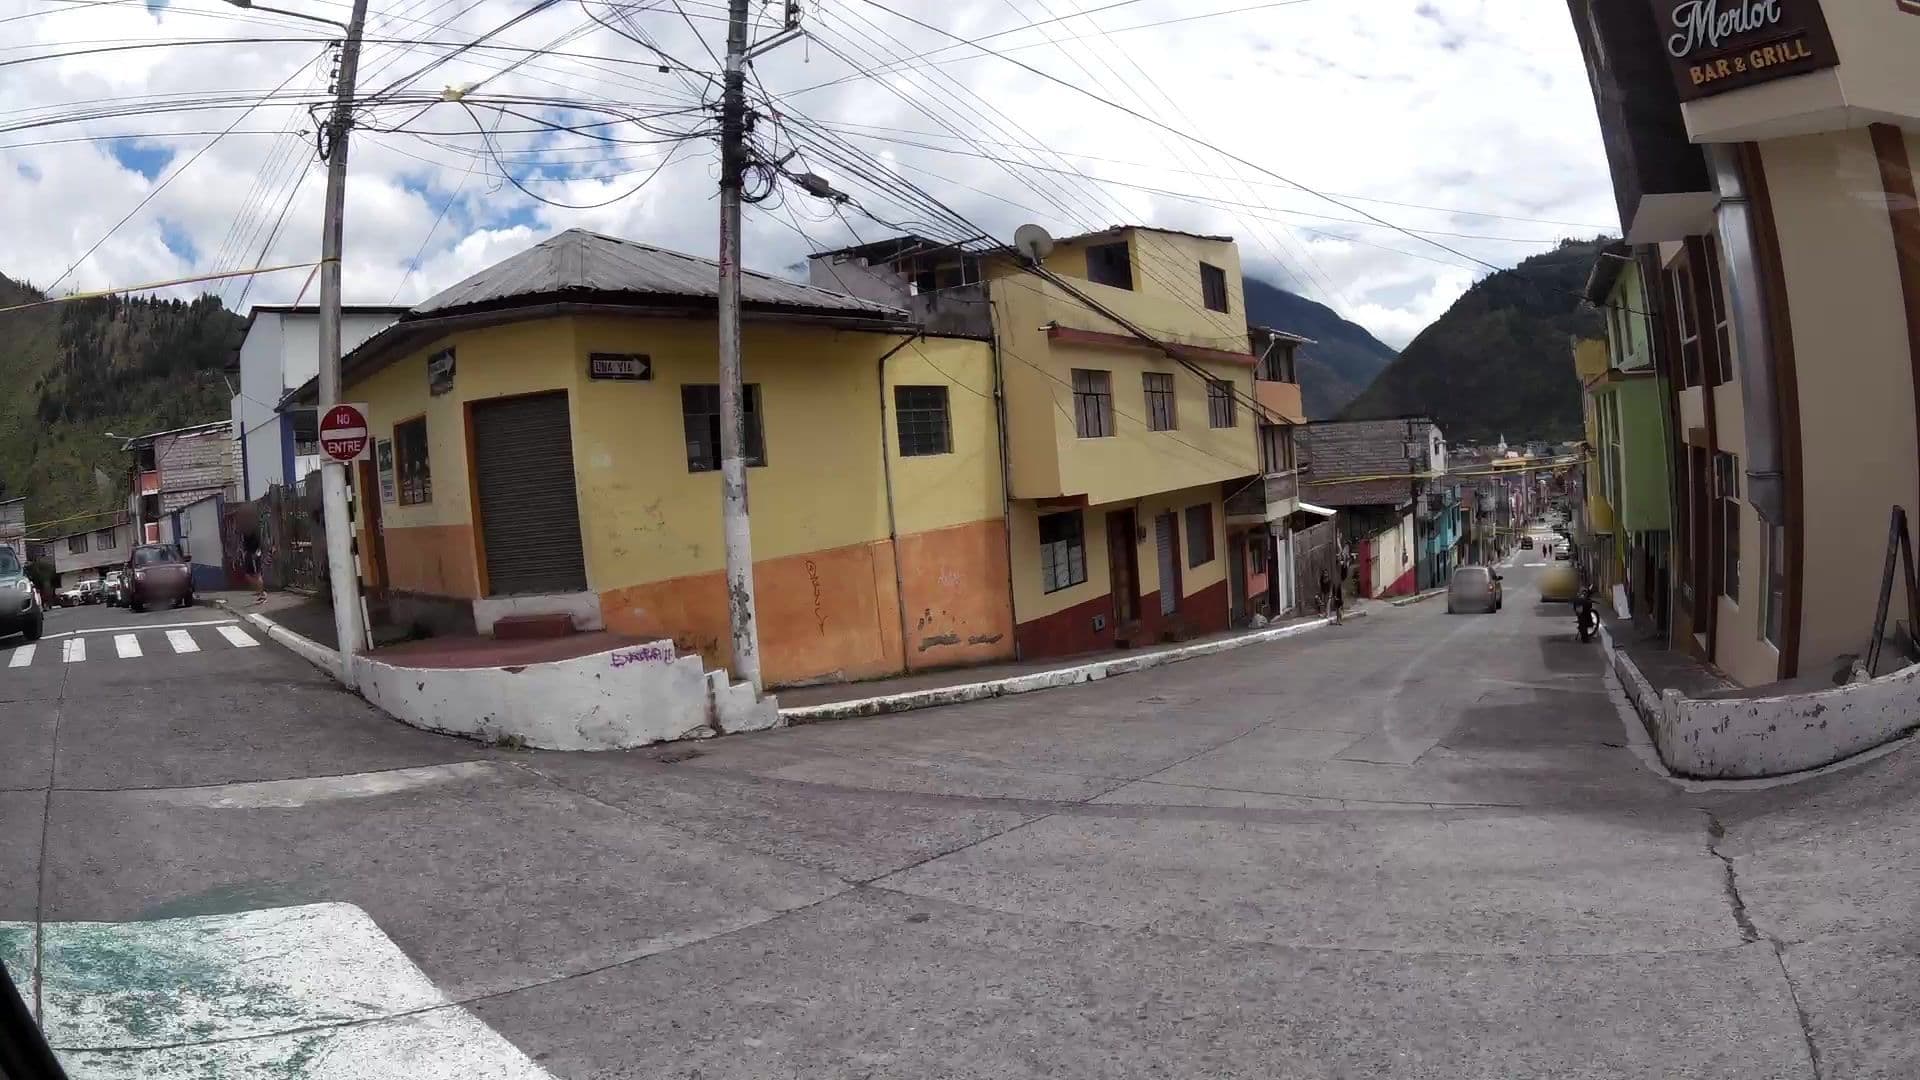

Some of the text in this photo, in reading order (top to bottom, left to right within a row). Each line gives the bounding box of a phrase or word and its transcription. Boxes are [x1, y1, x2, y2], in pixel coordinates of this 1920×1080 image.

[1668, 0, 1781, 57] Merlot
[1689, 39, 1812, 85] BAR & GRILL
[336, 413, 350, 425] NO
[327, 440, 361, 454] ENTRE
